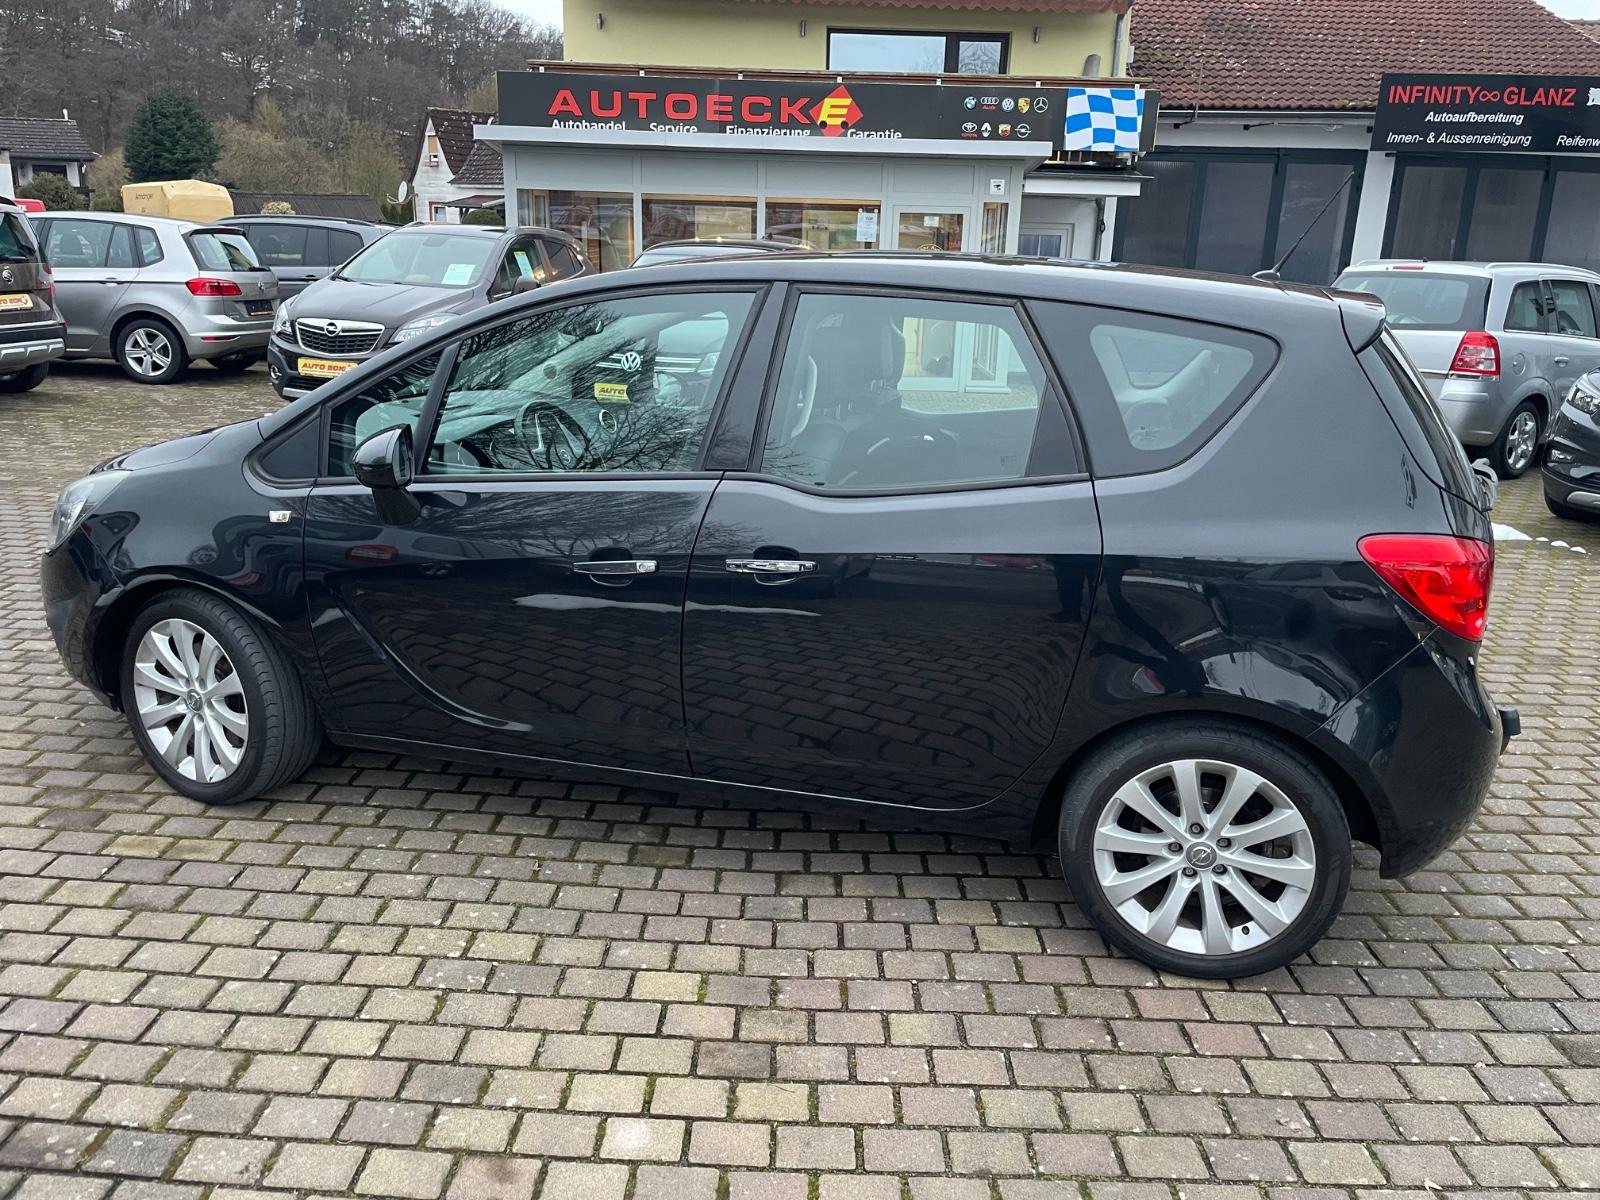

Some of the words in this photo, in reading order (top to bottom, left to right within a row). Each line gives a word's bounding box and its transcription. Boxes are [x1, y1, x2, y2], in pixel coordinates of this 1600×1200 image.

[1388, 85, 1480, 105] INFINITY
[1503, 86, 1577, 106] GLANZ
[1424, 112, 1524, 126] Autoaufbereitung
[551, 119, 626, 131] Autohandel
[649, 122, 698, 133] Service
[726, 125, 811, 136] Finanzierung
[847, 128, 902, 139] Garantie
[1386, 132, 1424, 144] Innen-
[1426, 132, 1435, 144] &
[1437, 132, 1532, 147] Aussenreinigung
[302, 362, 326, 371] AUTO
[598, 386, 625, 395] AUTO
